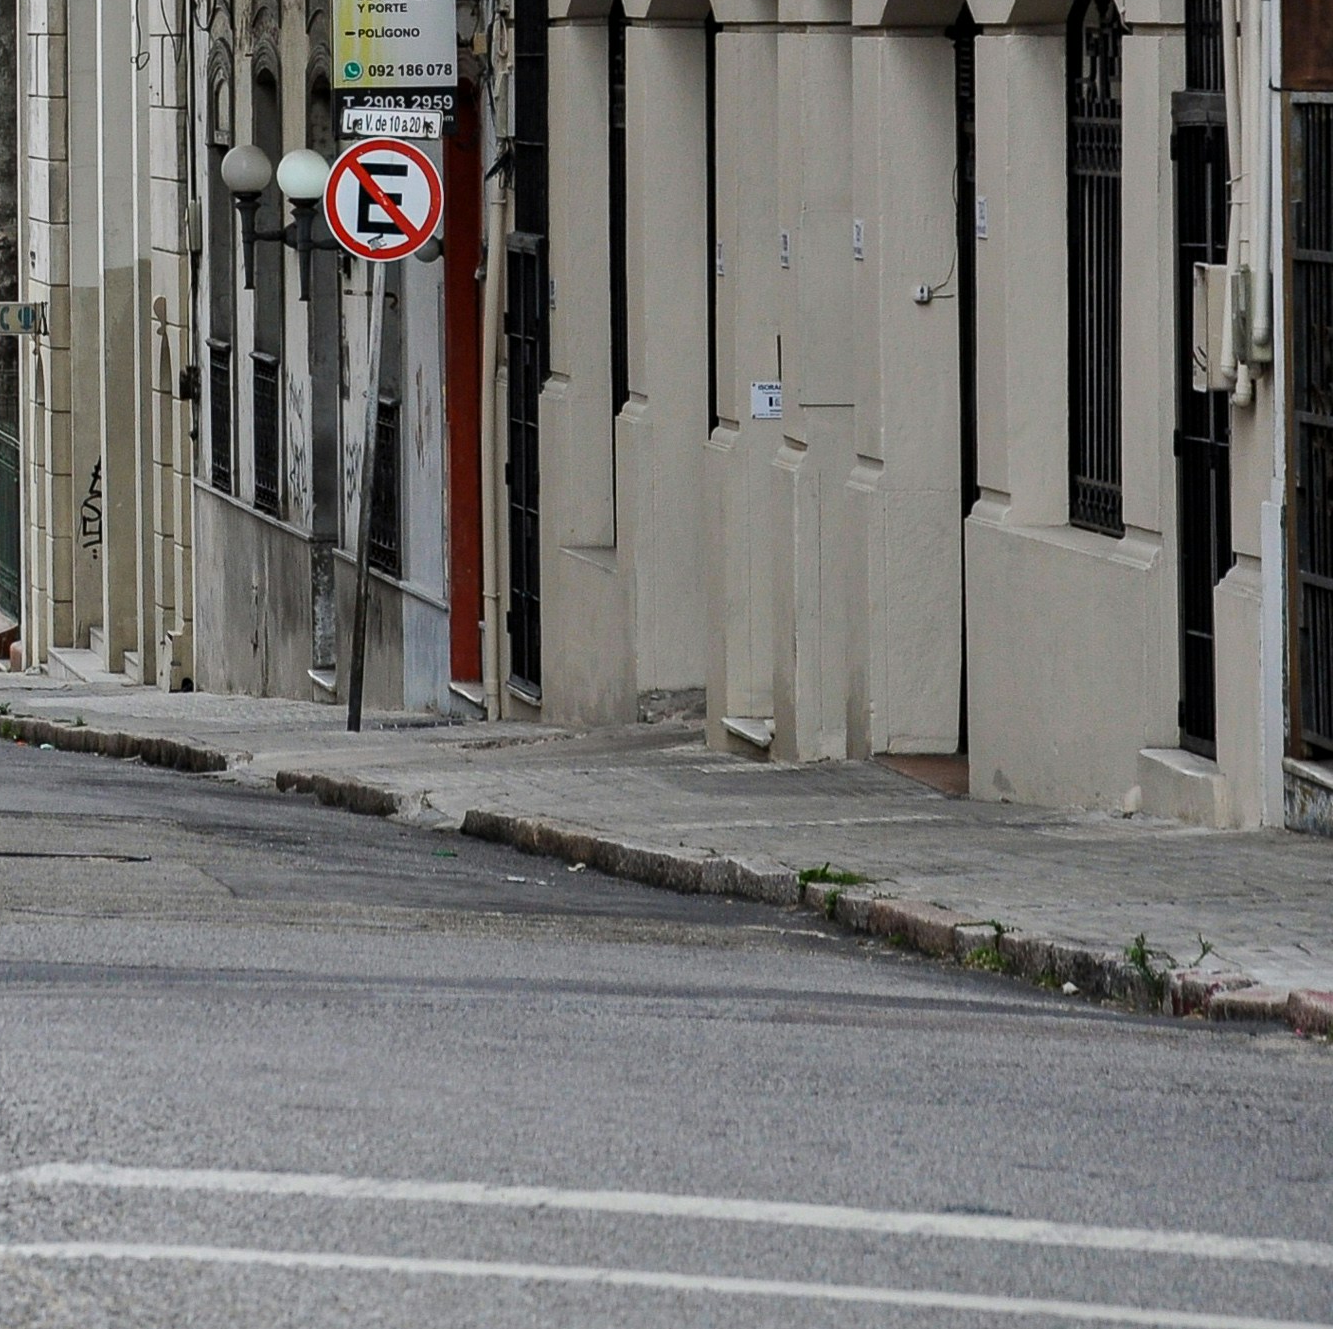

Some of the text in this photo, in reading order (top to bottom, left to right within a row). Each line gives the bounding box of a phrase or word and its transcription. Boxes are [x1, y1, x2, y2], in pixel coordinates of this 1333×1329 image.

[357, 3, 408, 13] Y PORTE
[358, 25, 420, 38] POLÍGONO
[368, 63, 453, 77] 092 186 078
[363, 96, 406, 109] 2903
[411, 95, 454, 110] 2959
[375, 115, 387, 132] de
[390, 116, 400, 133] 10
[401, 119, 408, 133] a
[409, 116, 421, 133] 20
